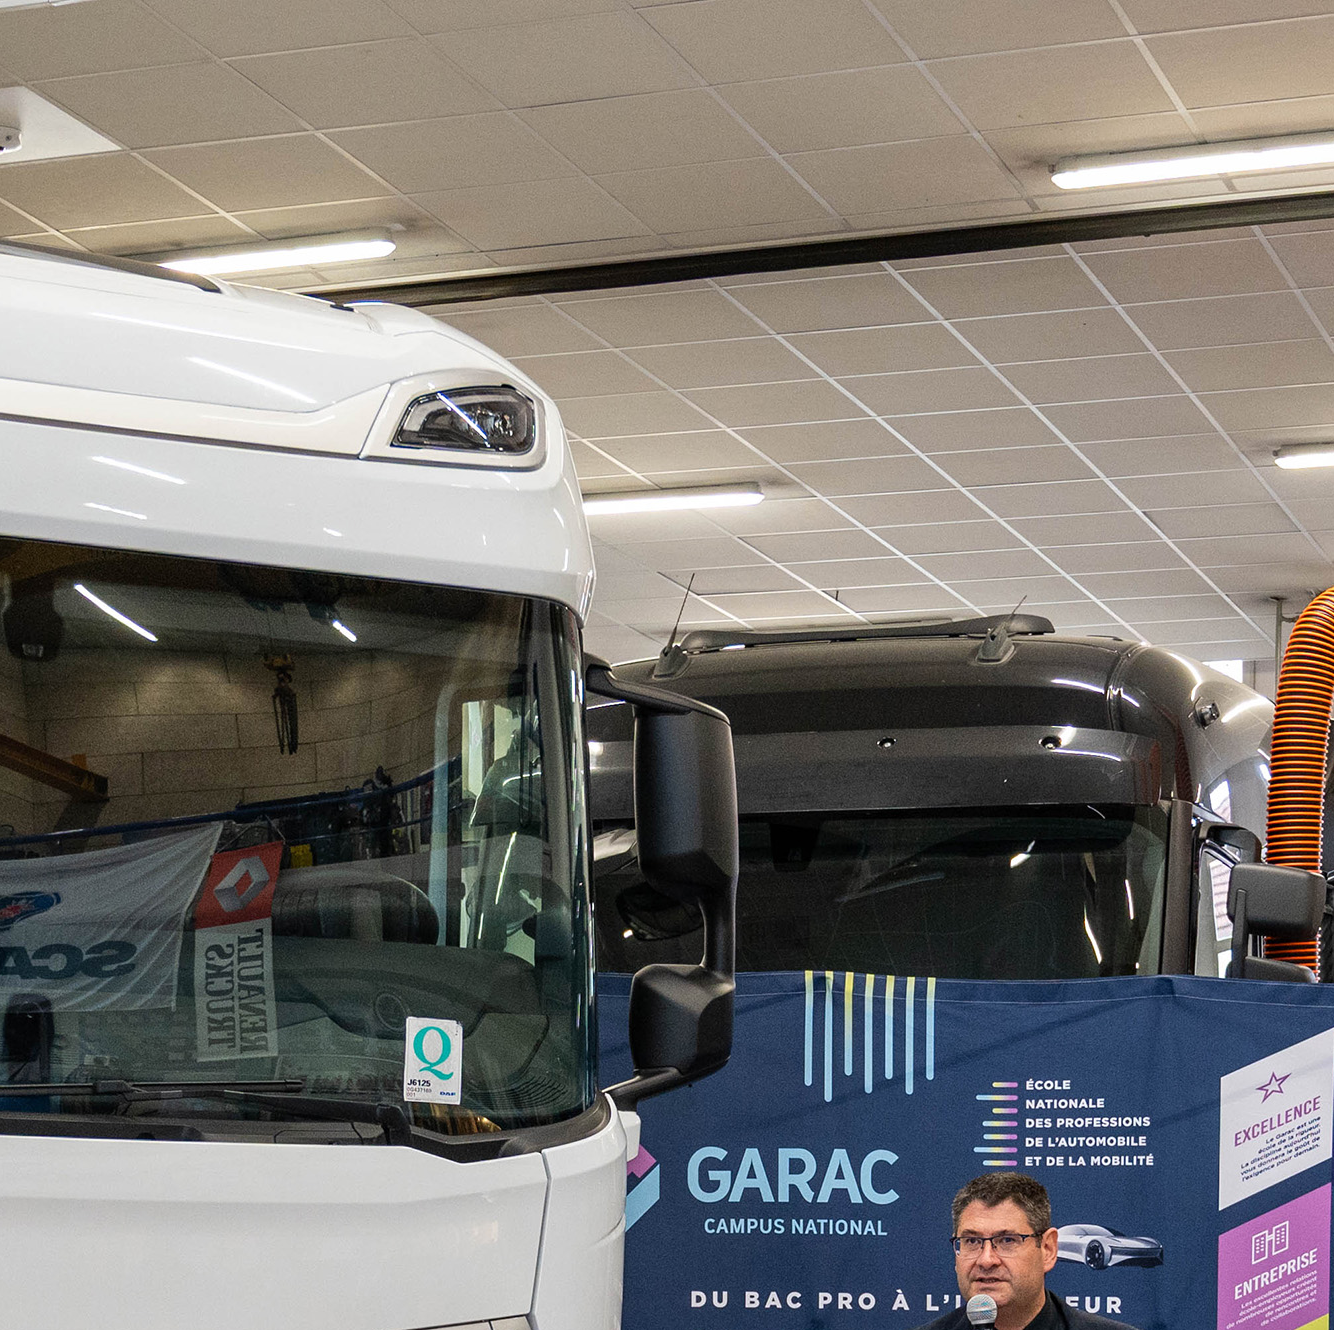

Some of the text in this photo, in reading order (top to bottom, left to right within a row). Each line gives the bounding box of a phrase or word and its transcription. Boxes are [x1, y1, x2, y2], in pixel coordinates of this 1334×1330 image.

[413, 1026, 454, 1080] Q
[407, 1079, 431, 1087] J6125
[1025, 1078, 1071, 1091] ÉCOLE
[1025, 1097, 1105, 1110] NATIONALE
[1025, 1115, 1151, 1128] DES PROFESSIONS
[1234, 1095, 1321, 1147] EXCELLENCE
[1276, 1128, 1295, 1139] Garac
[1308, 1116, 1321, 1125] une
[1025, 1135, 1147, 1147] DE L’AUTOMOBILE
[1258, 1142, 1276, 1154] école
[1278, 1138, 1286, 1146] de
[1025, 1152, 1154, 1167] ET DE LA MOBILITÉ
[1241, 1166, 1256, 1176] vous
[1258, 1153, 1285, 1168] donnera
[1251, 1148, 1282, 1165] discipline
[1276, 1156, 1292, 1168] pour
[688, 1147, 899, 1205] GARAC
[704, 1218, 887, 1236] CAMPUS NATIONAL
[1235, 1248, 1318, 1300] ENTREPRISE
[690, 1291, 728, 1308] DU
[745, 1291, 802, 1309] BAC
[819, 1292, 875, 1310] PRO
[892, 1288, 910, 1310] À
